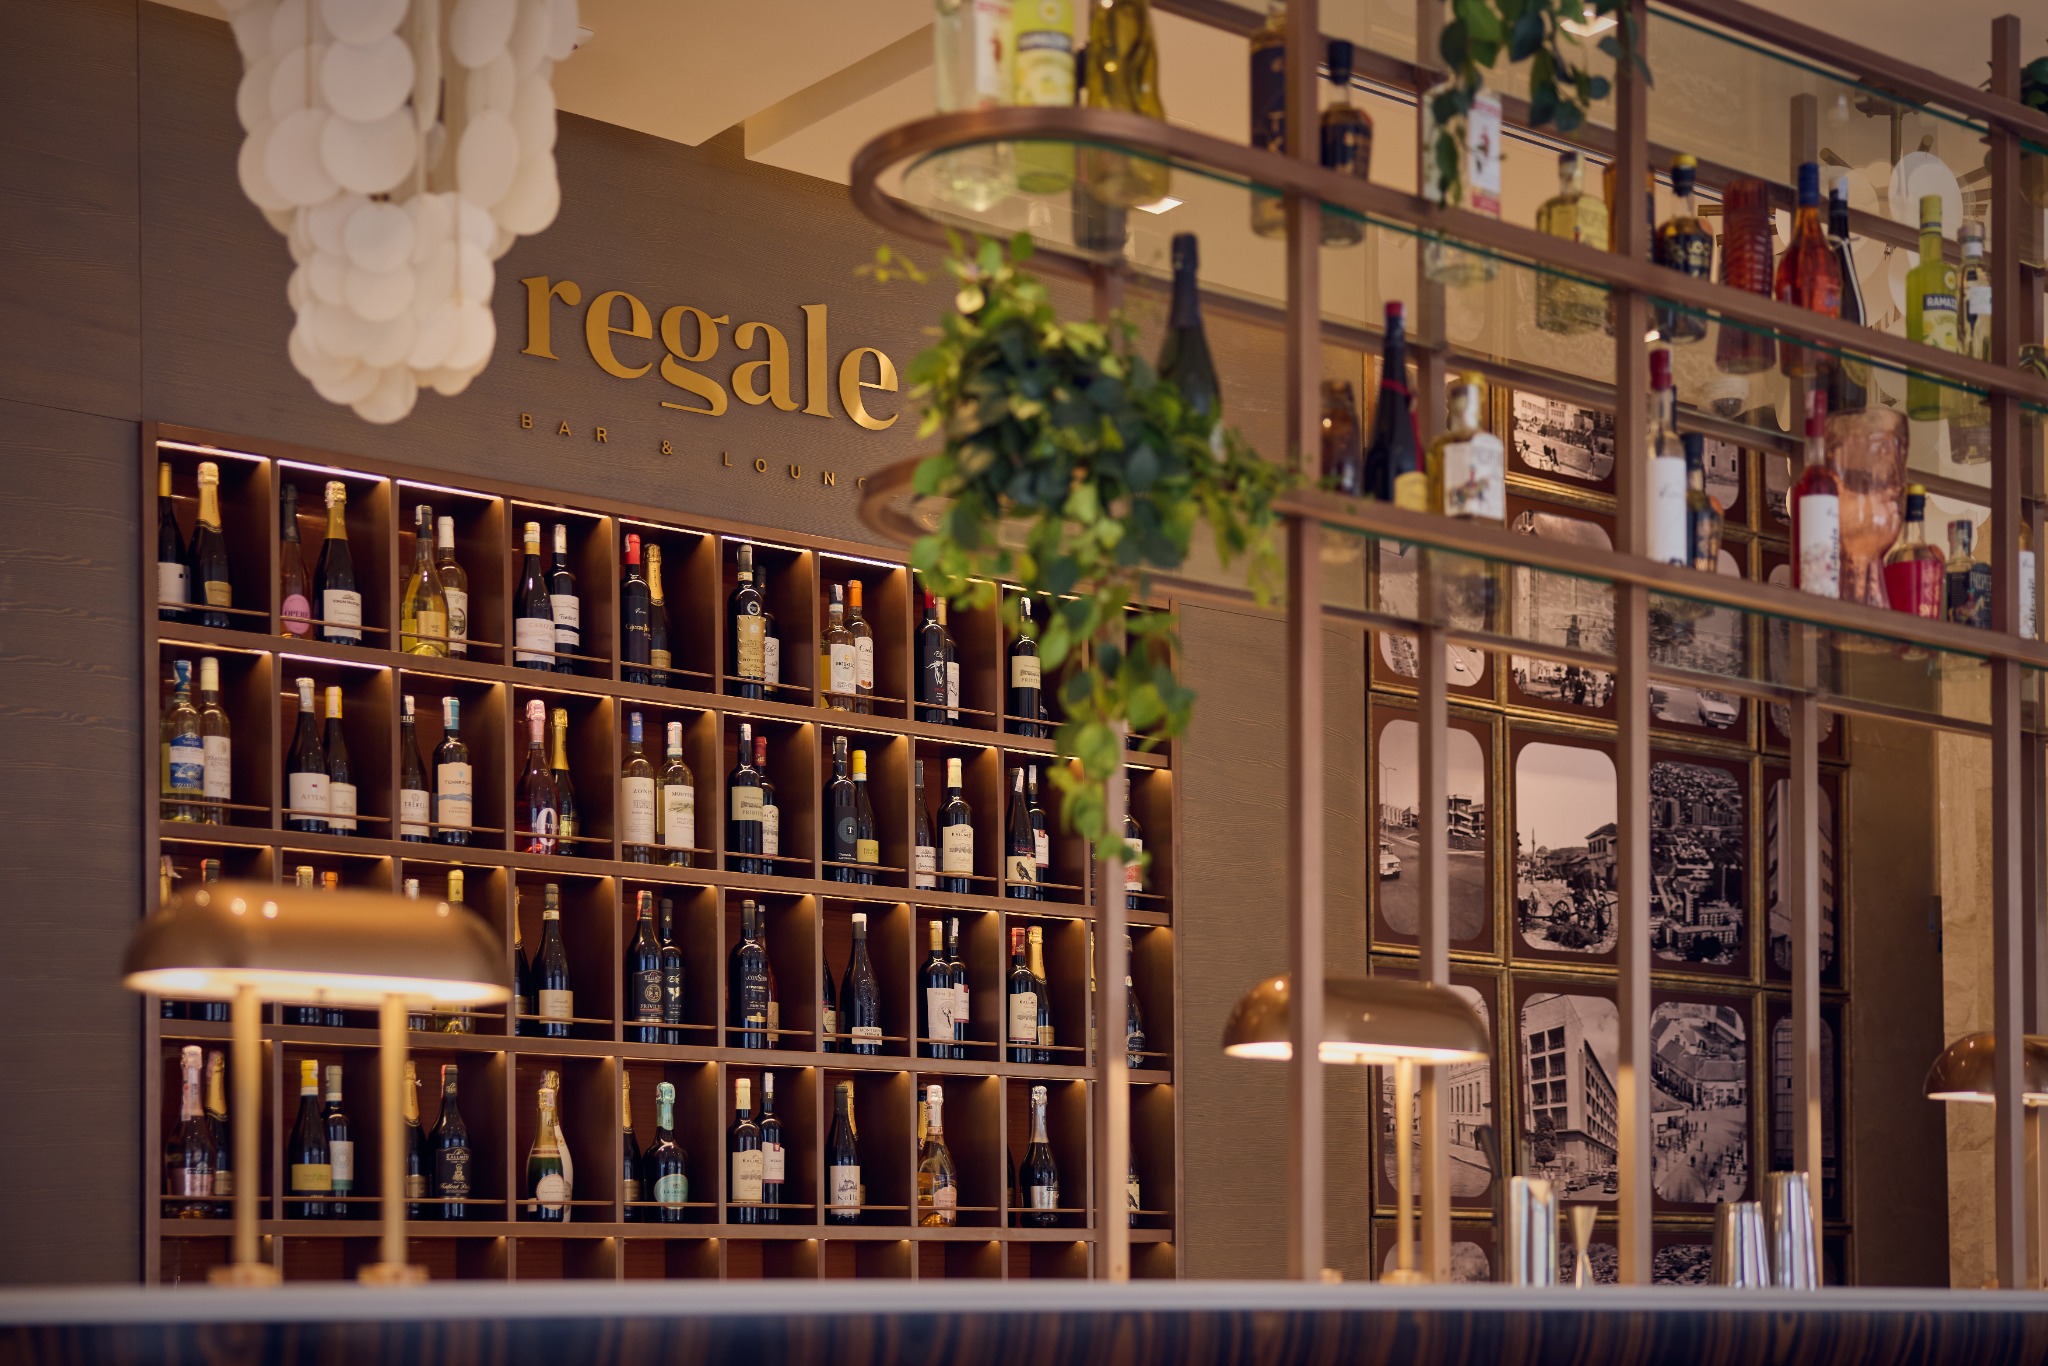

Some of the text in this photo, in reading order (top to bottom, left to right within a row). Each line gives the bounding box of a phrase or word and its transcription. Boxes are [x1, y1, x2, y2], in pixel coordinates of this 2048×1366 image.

[520, 275, 899, 430] regale
[521, 413, 608, 443] BAR
[661, 440, 673, 455] &
